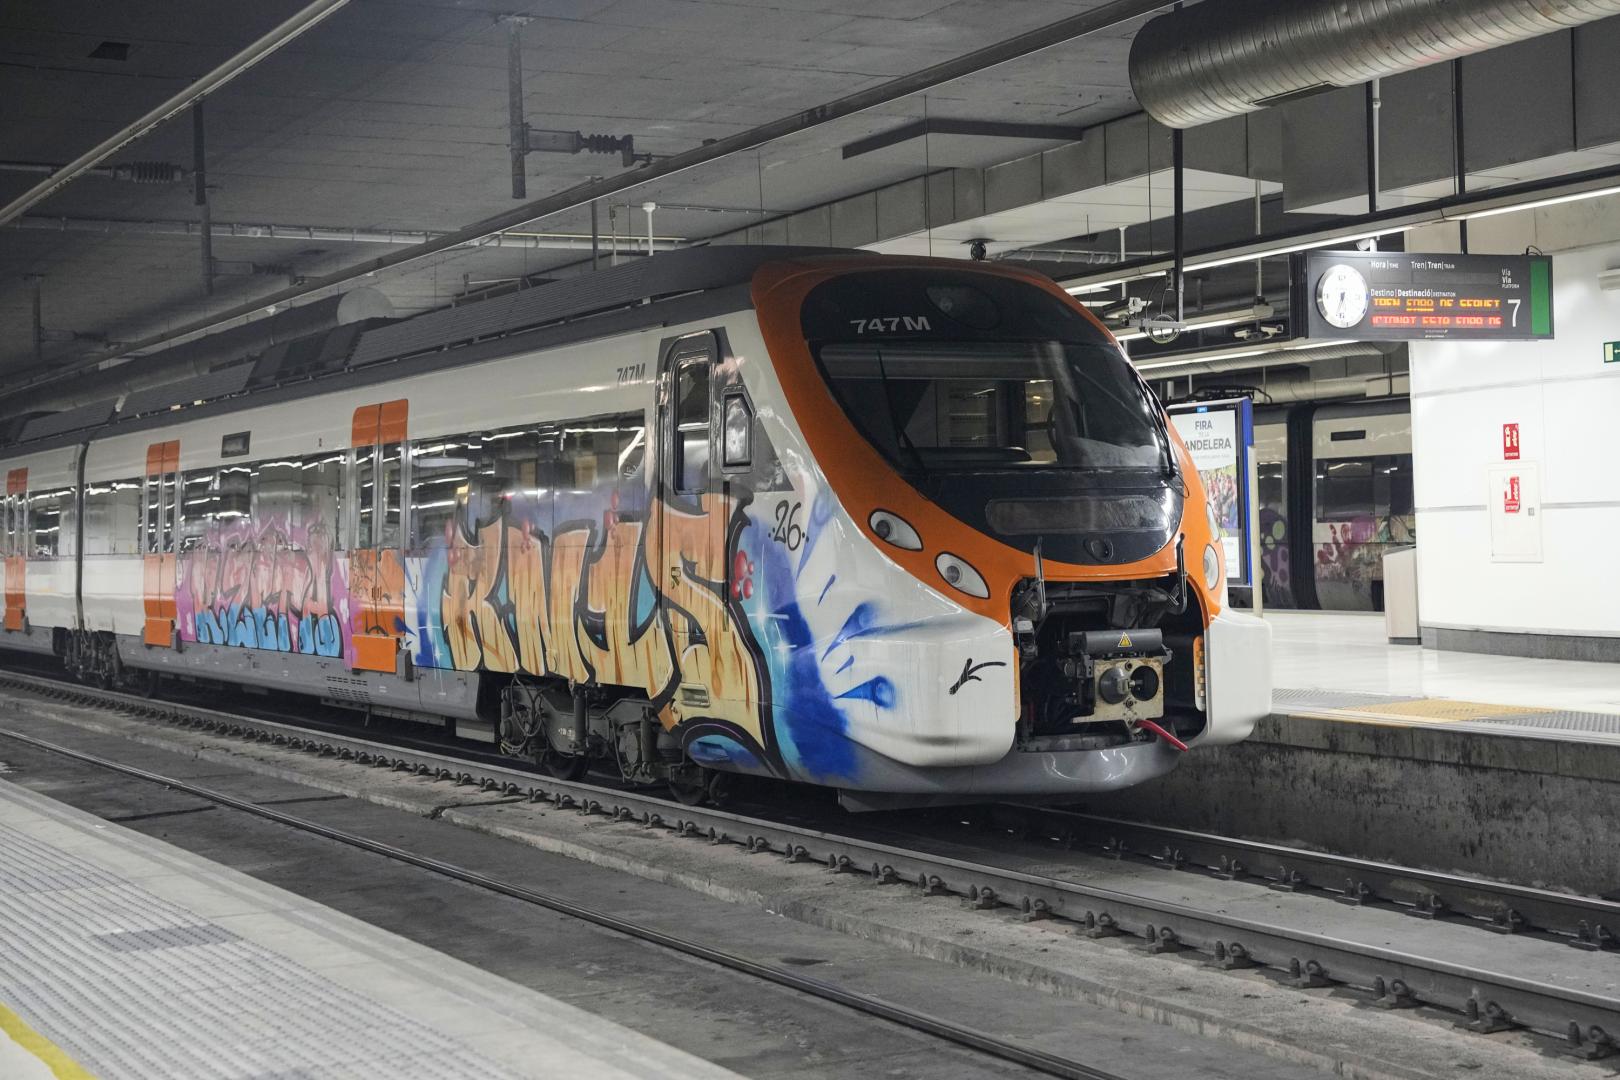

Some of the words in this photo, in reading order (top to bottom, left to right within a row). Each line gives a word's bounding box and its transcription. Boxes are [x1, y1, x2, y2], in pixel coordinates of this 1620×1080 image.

[1370, 260, 1386, 269] Hora
[1411, 261, 1425, 269] Tren
[1427, 261, 1442, 269] Tren
[1370, 288, 1395, 297] Destino
[1397, 288, 1431, 297] Destinació
[1507, 298, 1521, 328] 7
[849, 315, 932, 334] 747M
[616, 362, 646, 383] 747M
[1194, 420, 1213, 431] FIRA
[1184, 437, 1232, 452] ANDELERA
